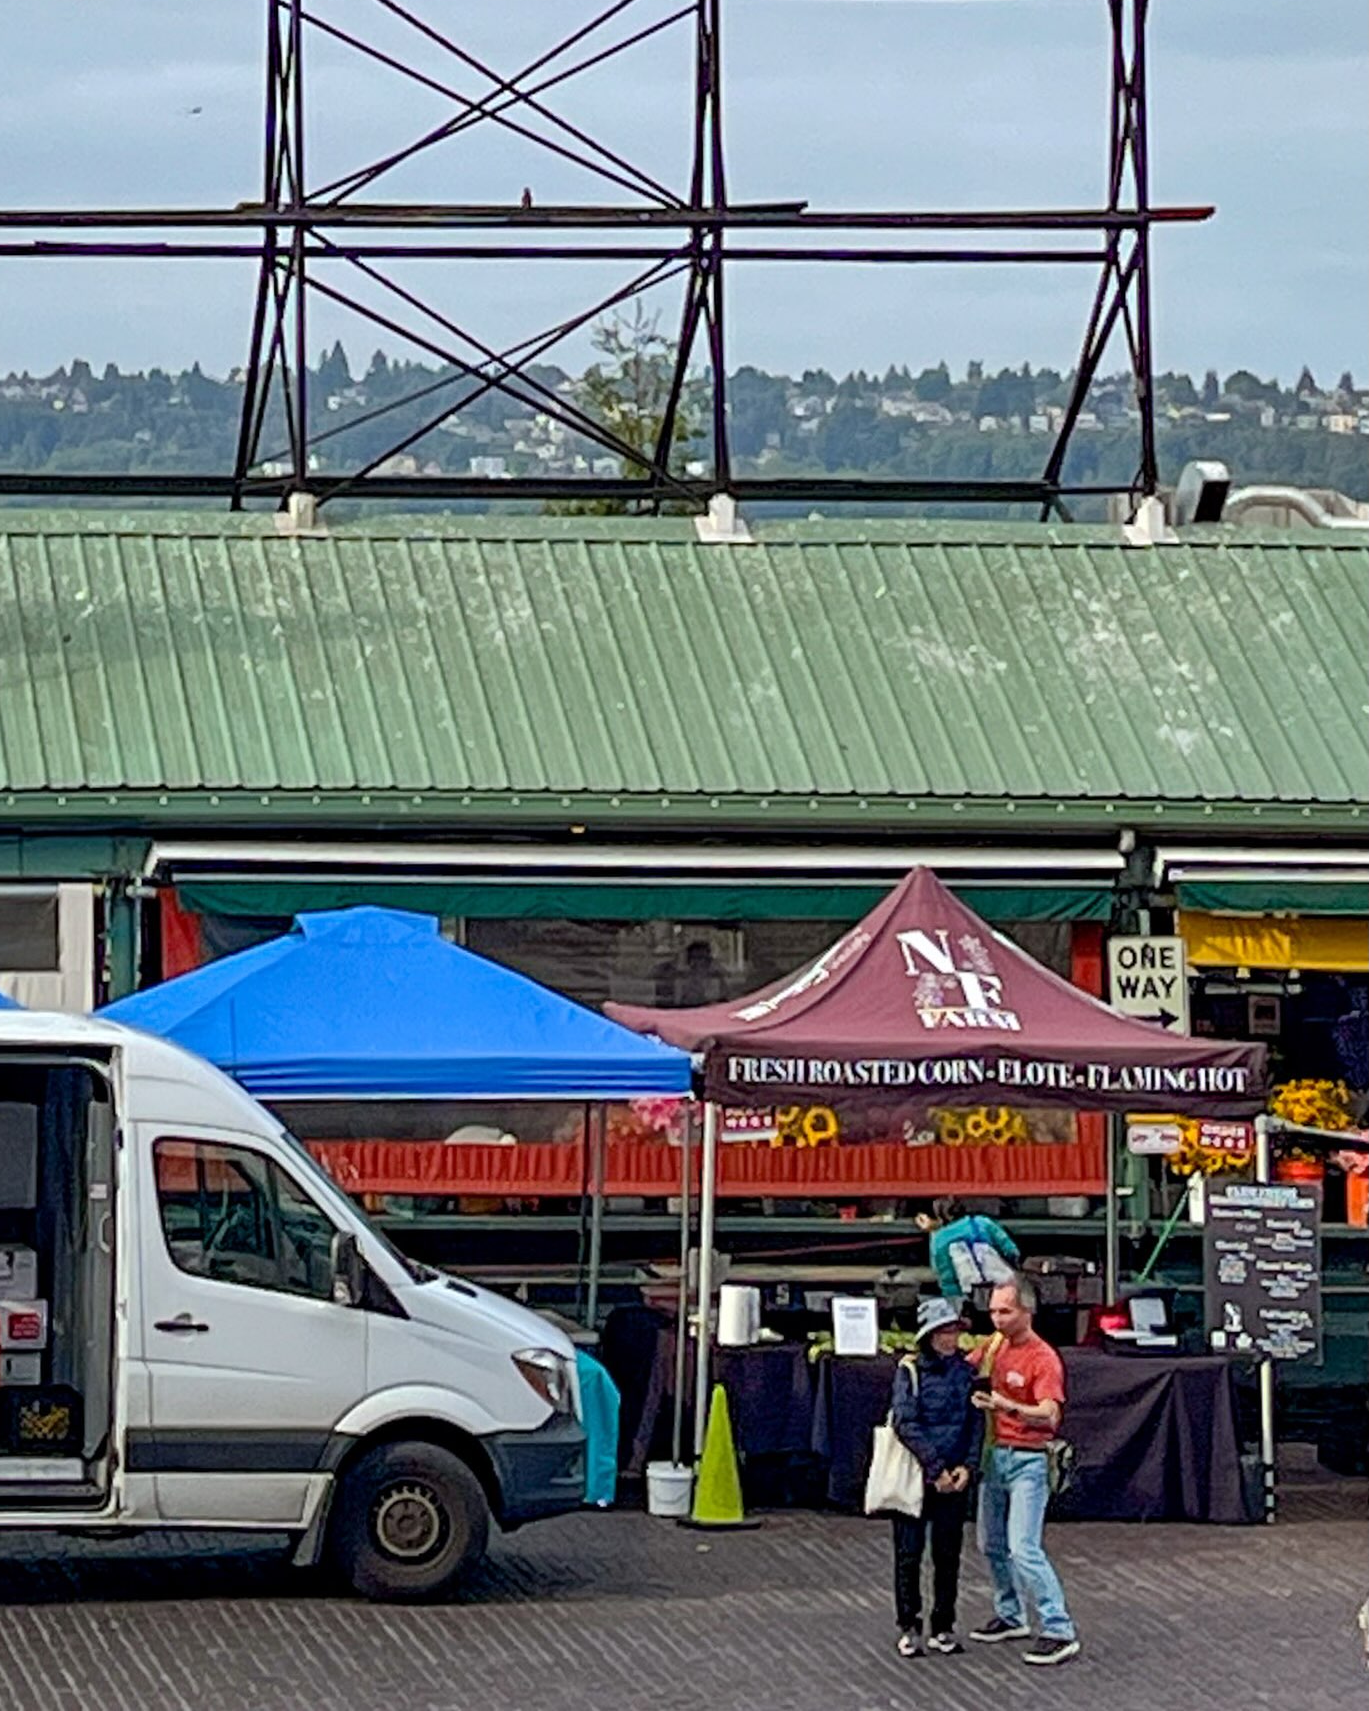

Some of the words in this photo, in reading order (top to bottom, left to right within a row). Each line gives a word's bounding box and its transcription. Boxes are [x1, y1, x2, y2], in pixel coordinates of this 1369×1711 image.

[1117, 945, 1176, 970] ONE
[1116, 974, 1178, 999] WAY
[728, 1057, 805, 1083] FRESH
[808, 1060, 916, 1084] ROASTED
[918, 1060, 984, 1085] CORN
[998, 1059, 1075, 1088] ELOTE
[1087, 1064, 1196, 1091] FLAMING
[1197, 1067, 1249, 1092] HOT
